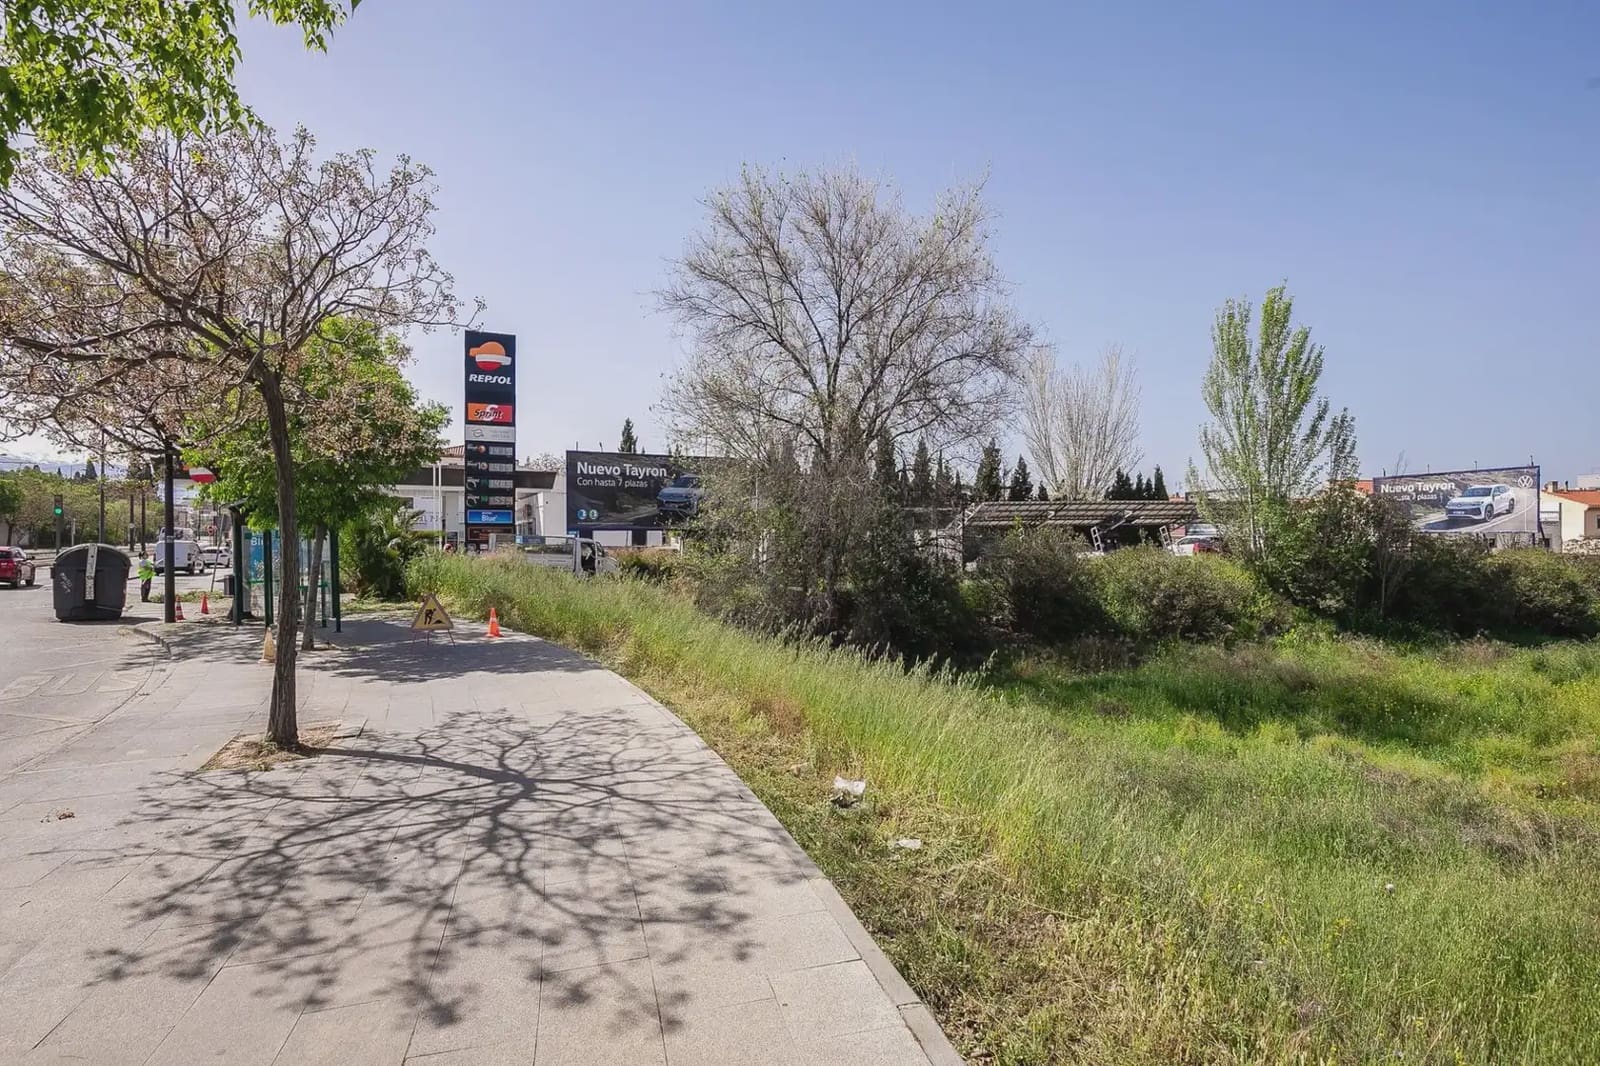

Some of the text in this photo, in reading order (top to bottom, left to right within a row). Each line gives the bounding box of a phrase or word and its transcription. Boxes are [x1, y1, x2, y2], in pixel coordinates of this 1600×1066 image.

[469, 374, 512, 385] REPSOL
[473, 407, 504, 420] Sprint
[577, 462, 667, 479] Nuevo Tayron
[577, 477, 648, 489] Con hasta 7 plazas
[1381, 482, 1455, 493] Nuevo Tayron
